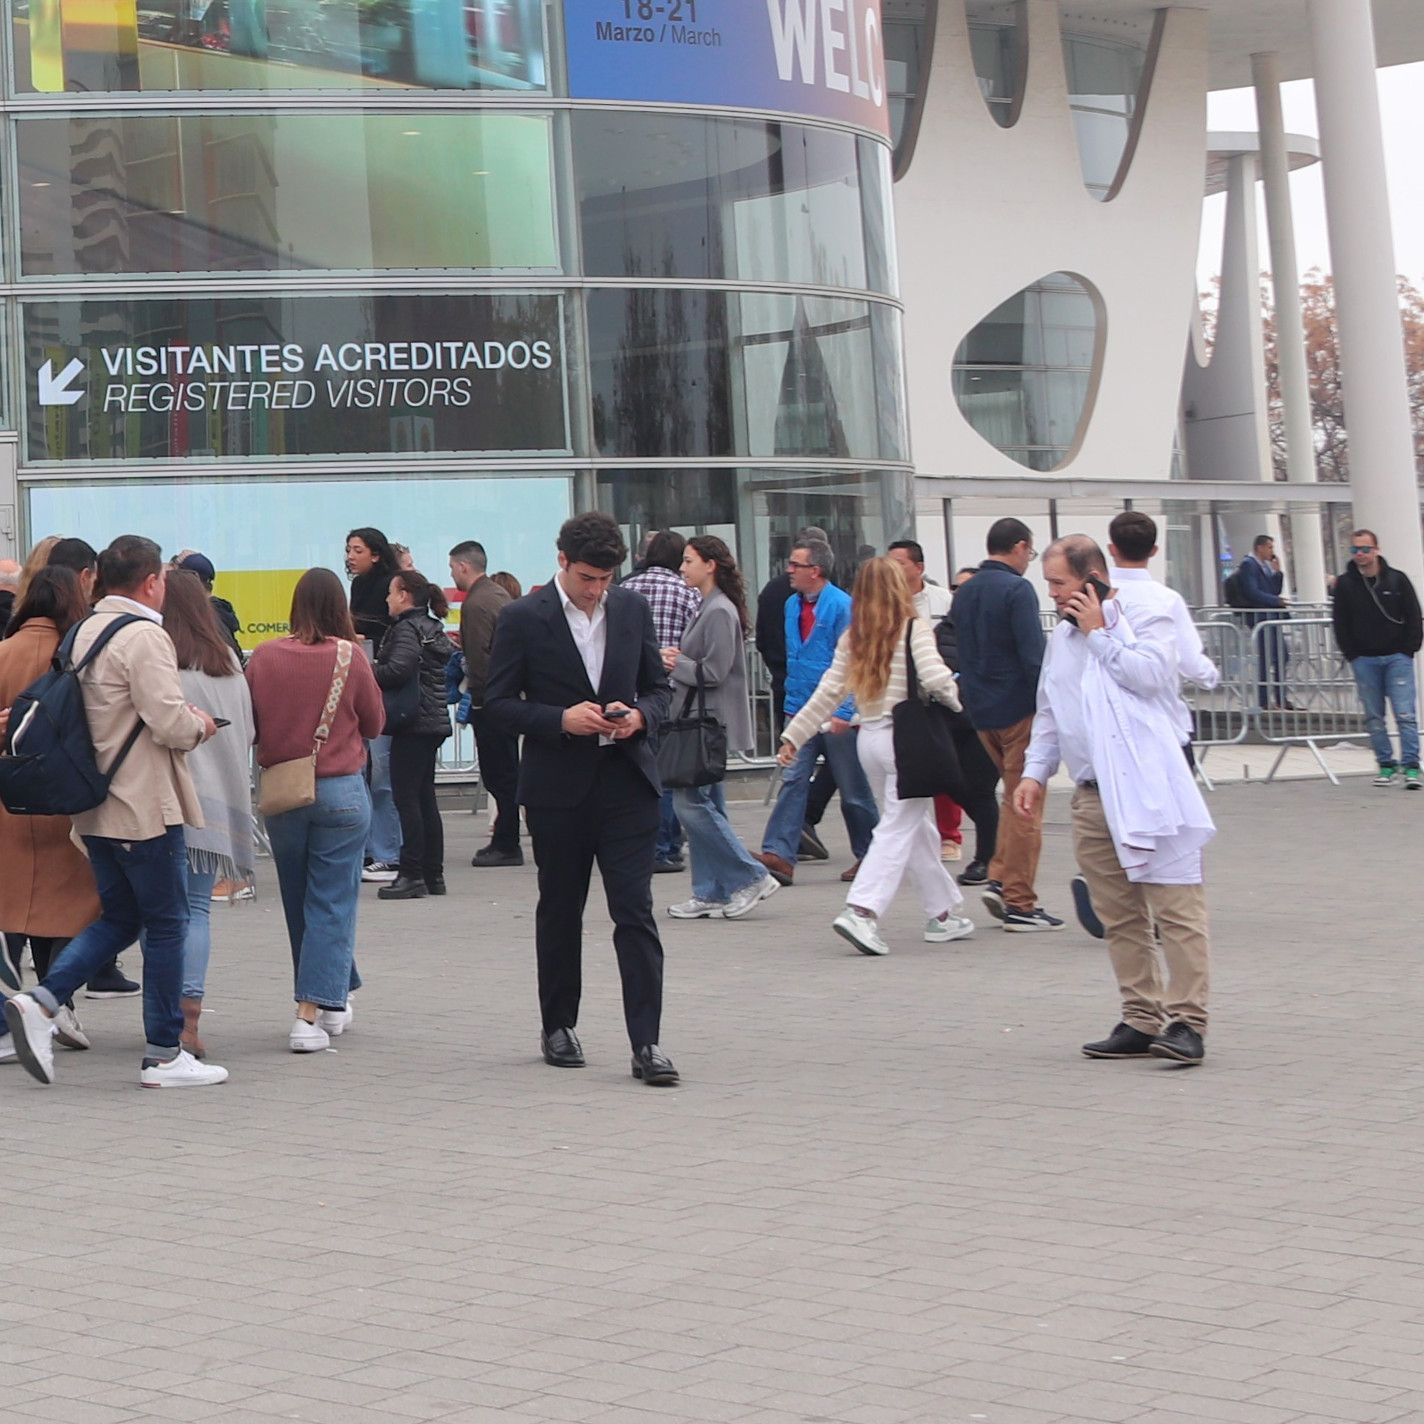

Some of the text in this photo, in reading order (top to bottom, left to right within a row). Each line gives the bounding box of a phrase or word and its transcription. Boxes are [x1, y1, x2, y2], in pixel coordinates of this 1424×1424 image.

[596, 21, 722, 47] Marzo / March
[101, 340, 552, 376] VISITANTES ACREDITADOS
[103, 377, 472, 412] REGISTERED VISITORS
[247, 622, 293, 634] COMER
